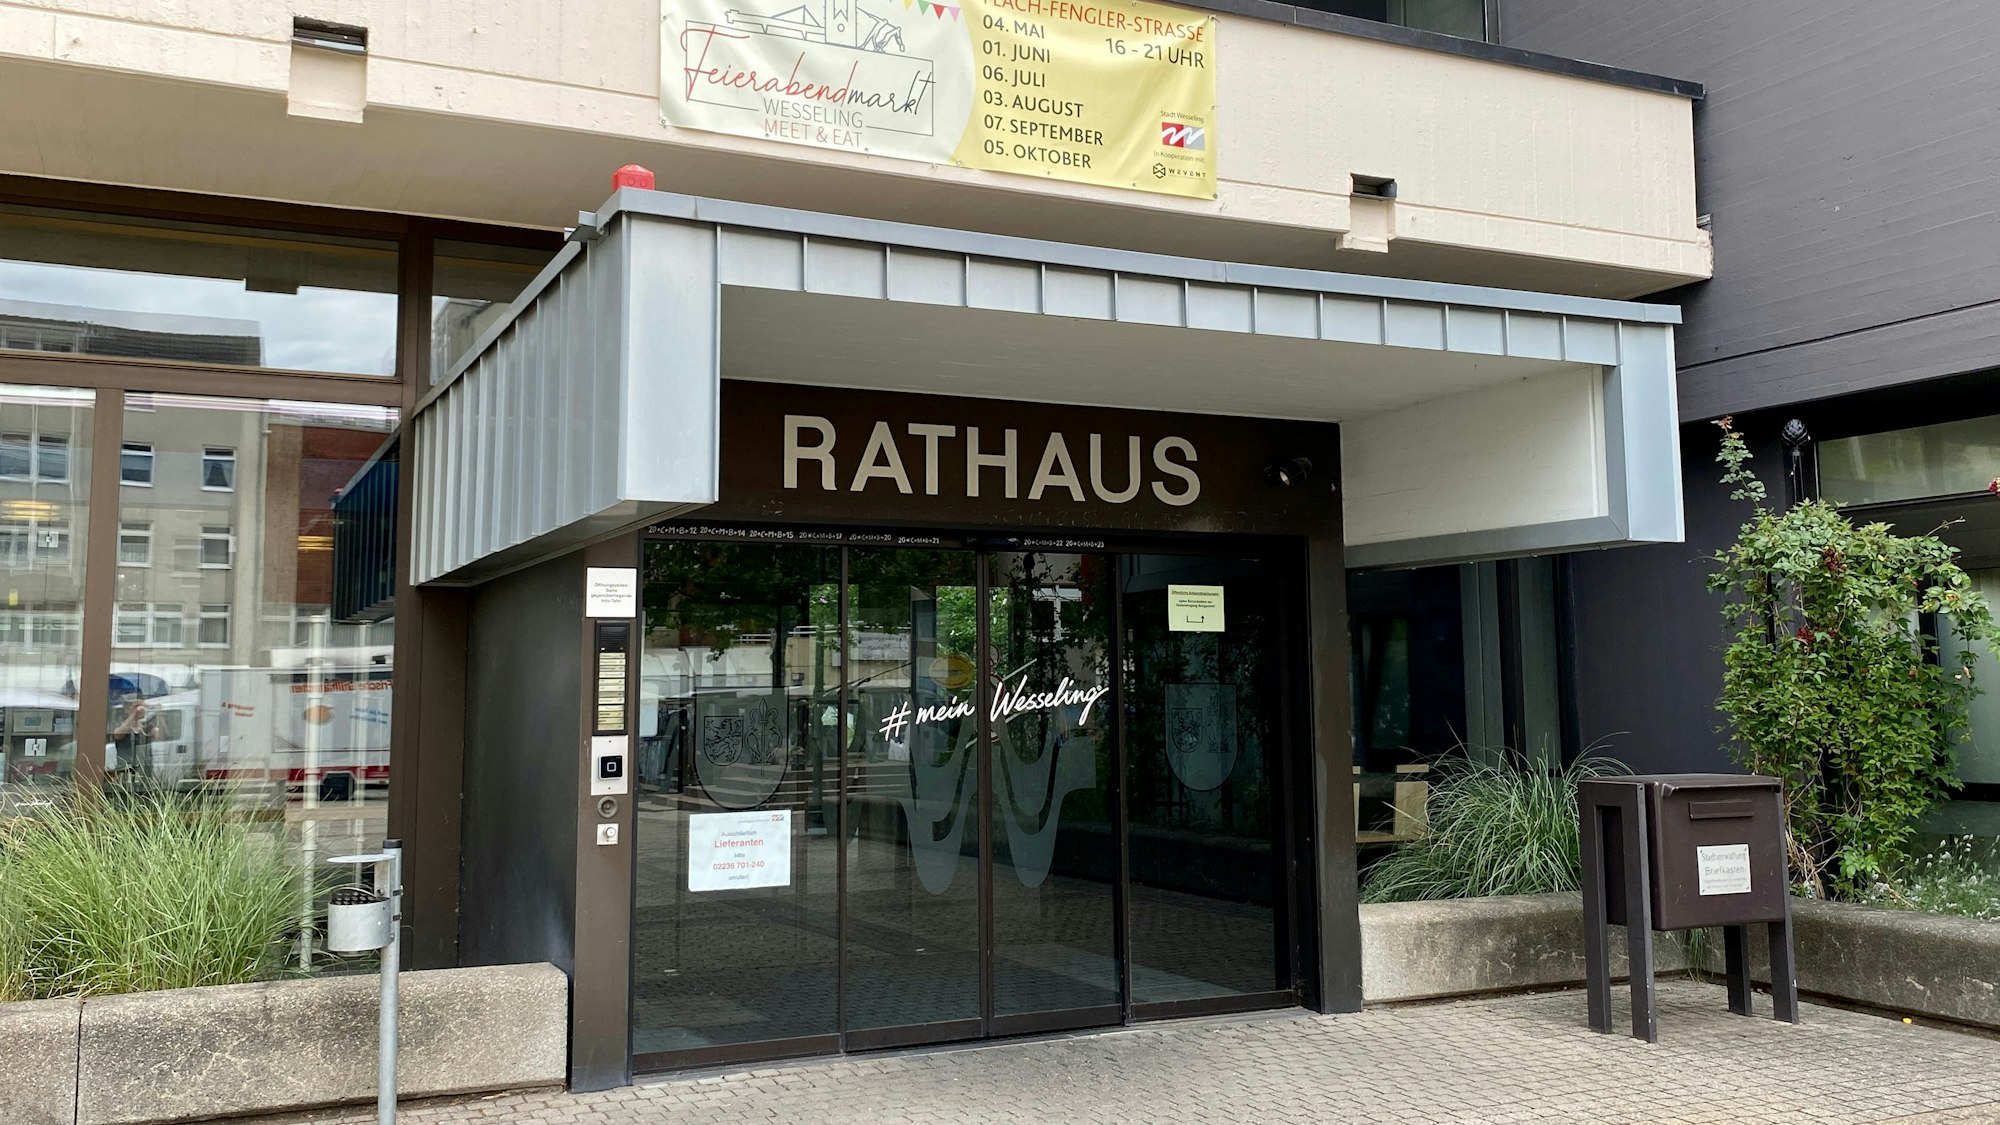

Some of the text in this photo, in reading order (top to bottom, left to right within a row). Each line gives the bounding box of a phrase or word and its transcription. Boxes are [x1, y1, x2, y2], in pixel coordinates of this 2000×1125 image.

[983, 14, 1045, 39] 04. MAI
[984, 0, 1204, 42] ACH-FENGLER-STRASSE
[983, 40, 1050, 63] 01. JUNI
[1105, 37, 1126, 55] 16
[1144, 43, 1162, 61] 21
[1168, 46, 1205, 68] UHR
[680, 25, 936, 116] Feierabendmarkt
[983, 65, 1045, 88] 06. JULI
[763, 98, 863, 128] WESSELING
[983, 90, 1084, 118] 03. AUGUST
[1160, 110, 1204, 124] Stadt Wesseling
[763, 118, 863, 148] MEET & EAT
[984, 114, 1103, 146] 07. SEPTEMBER
[984, 139, 1091, 169] 05. OKTOBER
[1160, 152, 1194, 162] Kooperation
[1168, 167, 1206, 178] WEVENT
[783, 414, 1201, 506] RATHAUS
[990, 675, 1109, 726] Wesseling
[714, 839, 764, 848] Lieferanten
[1705, 867, 1744, 875] Briefkasten
